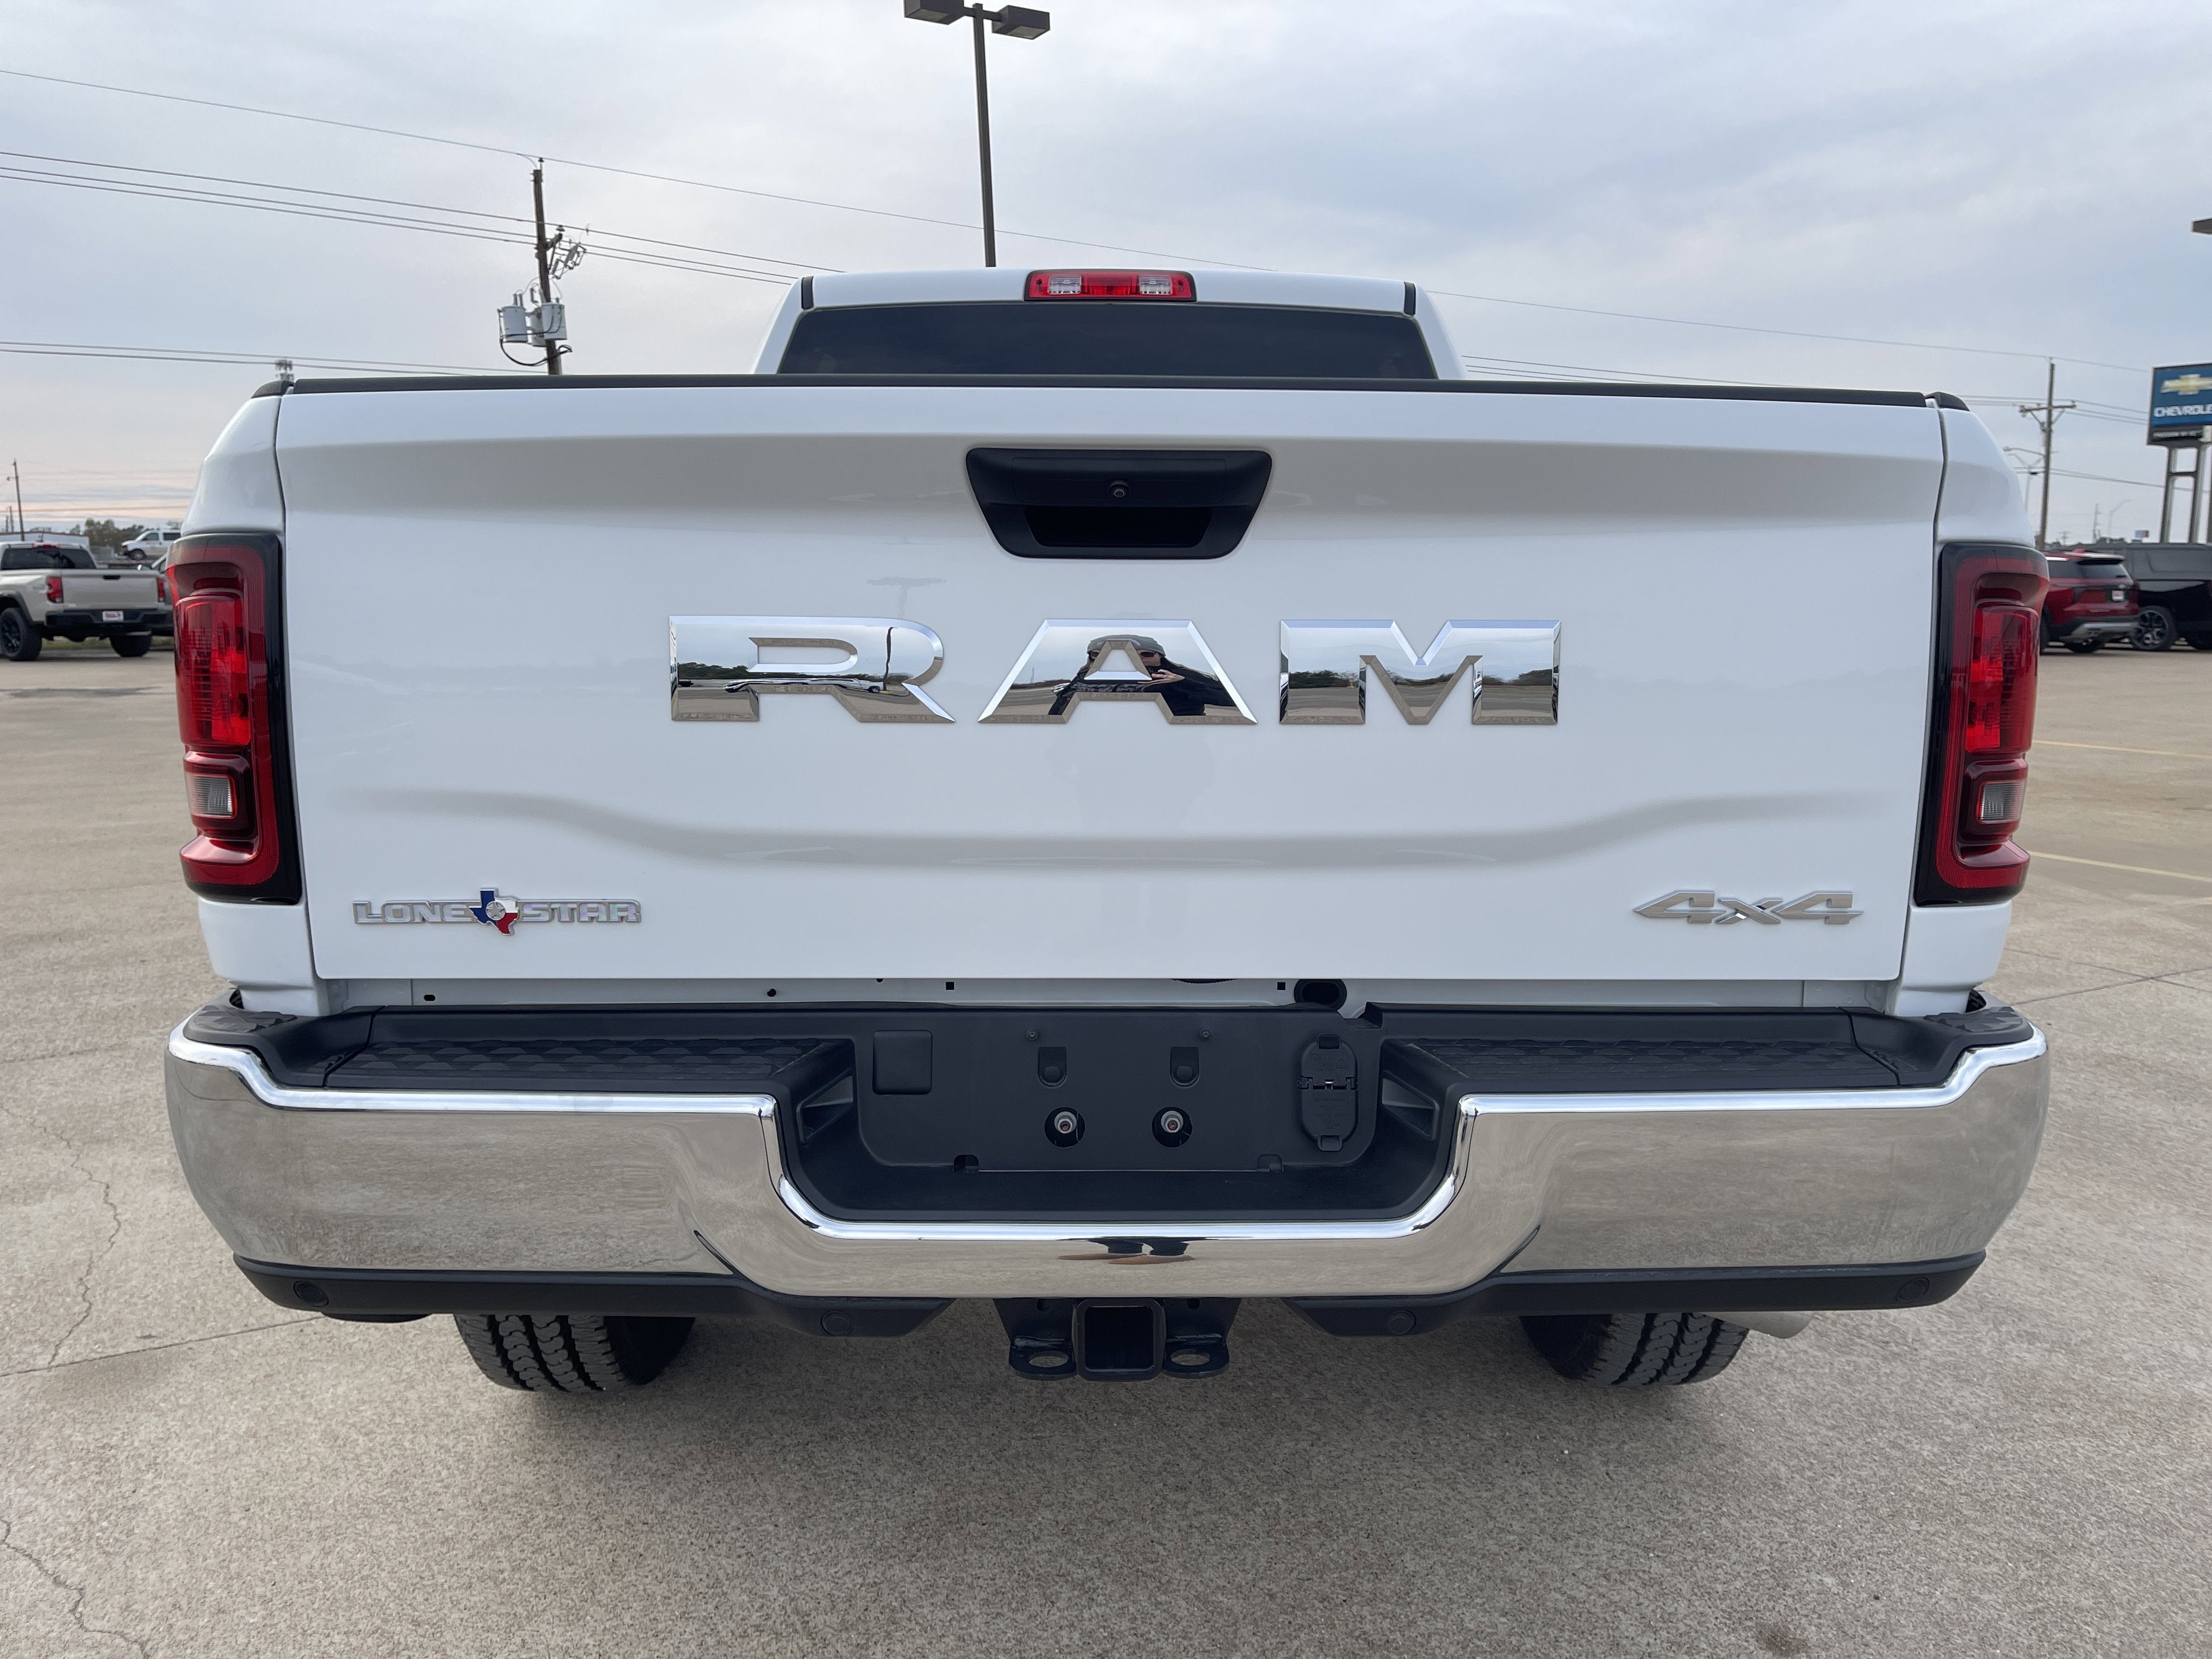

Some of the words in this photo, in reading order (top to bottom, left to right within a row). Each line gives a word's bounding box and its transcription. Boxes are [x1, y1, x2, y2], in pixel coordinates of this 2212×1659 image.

[669, 615, 1561, 725] RAM
[353, 900, 475, 924] LONE
[521, 899, 641, 923] STAR
